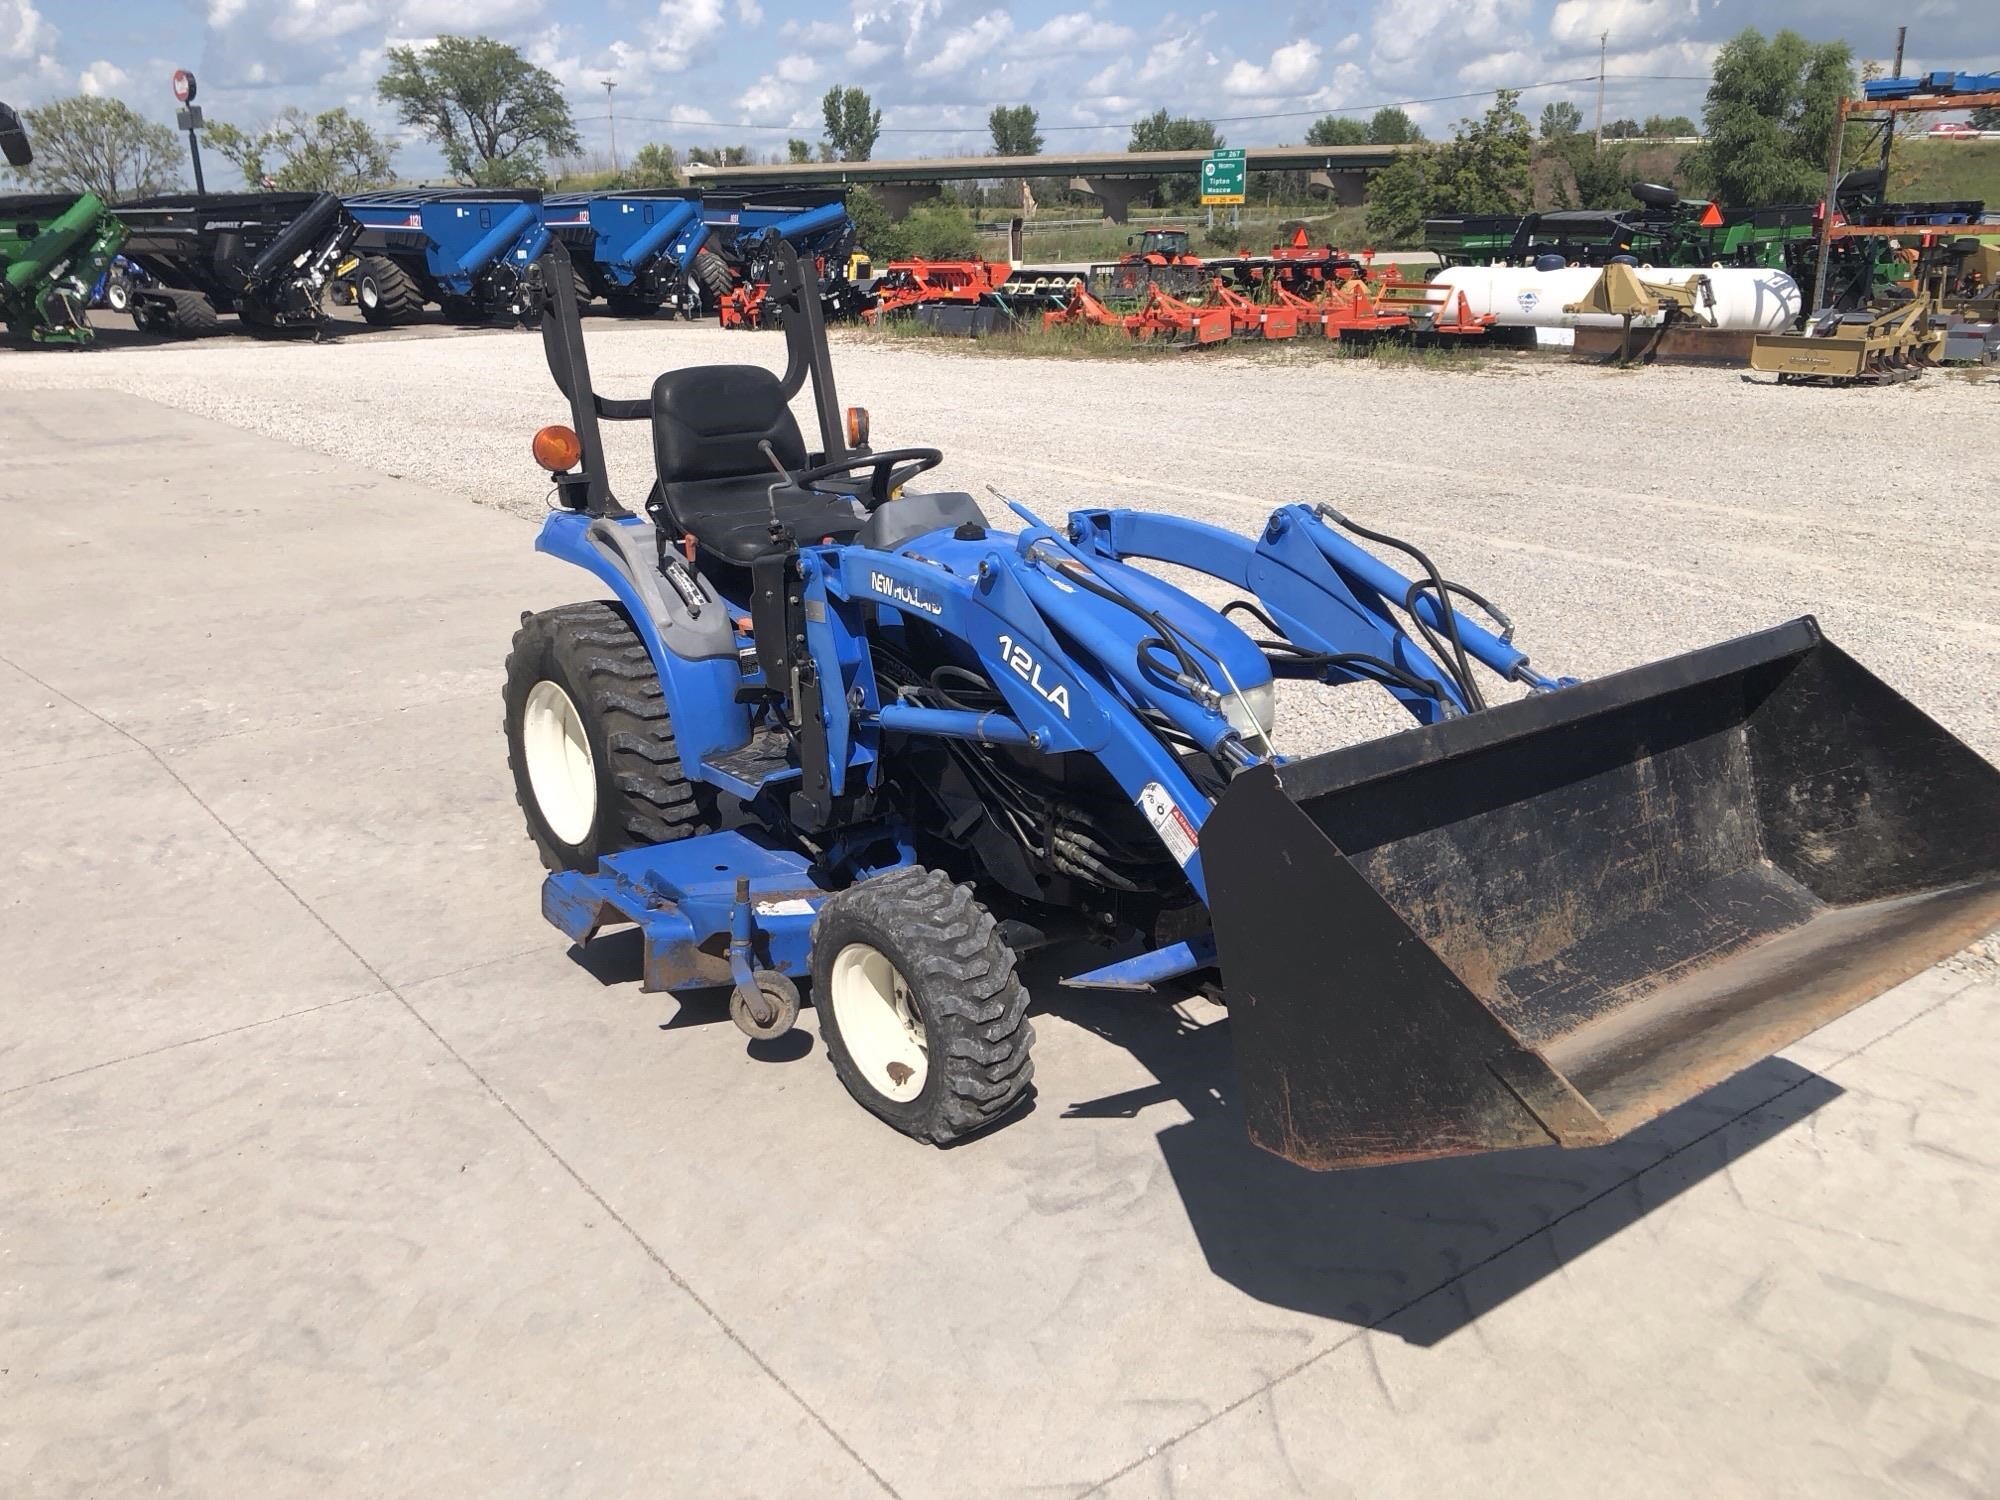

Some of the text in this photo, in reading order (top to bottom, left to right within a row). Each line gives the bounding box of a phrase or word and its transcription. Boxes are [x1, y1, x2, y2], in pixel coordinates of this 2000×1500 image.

[1209, 178, 1230, 186] Tipton
[409, 214, 422, 227] 1121
[579, 210, 590, 222] 1121
[871, 570, 894, 597] NEW
[998, 634, 1071, 720] 12LA
[1178, 813, 1200, 845] DANGER
